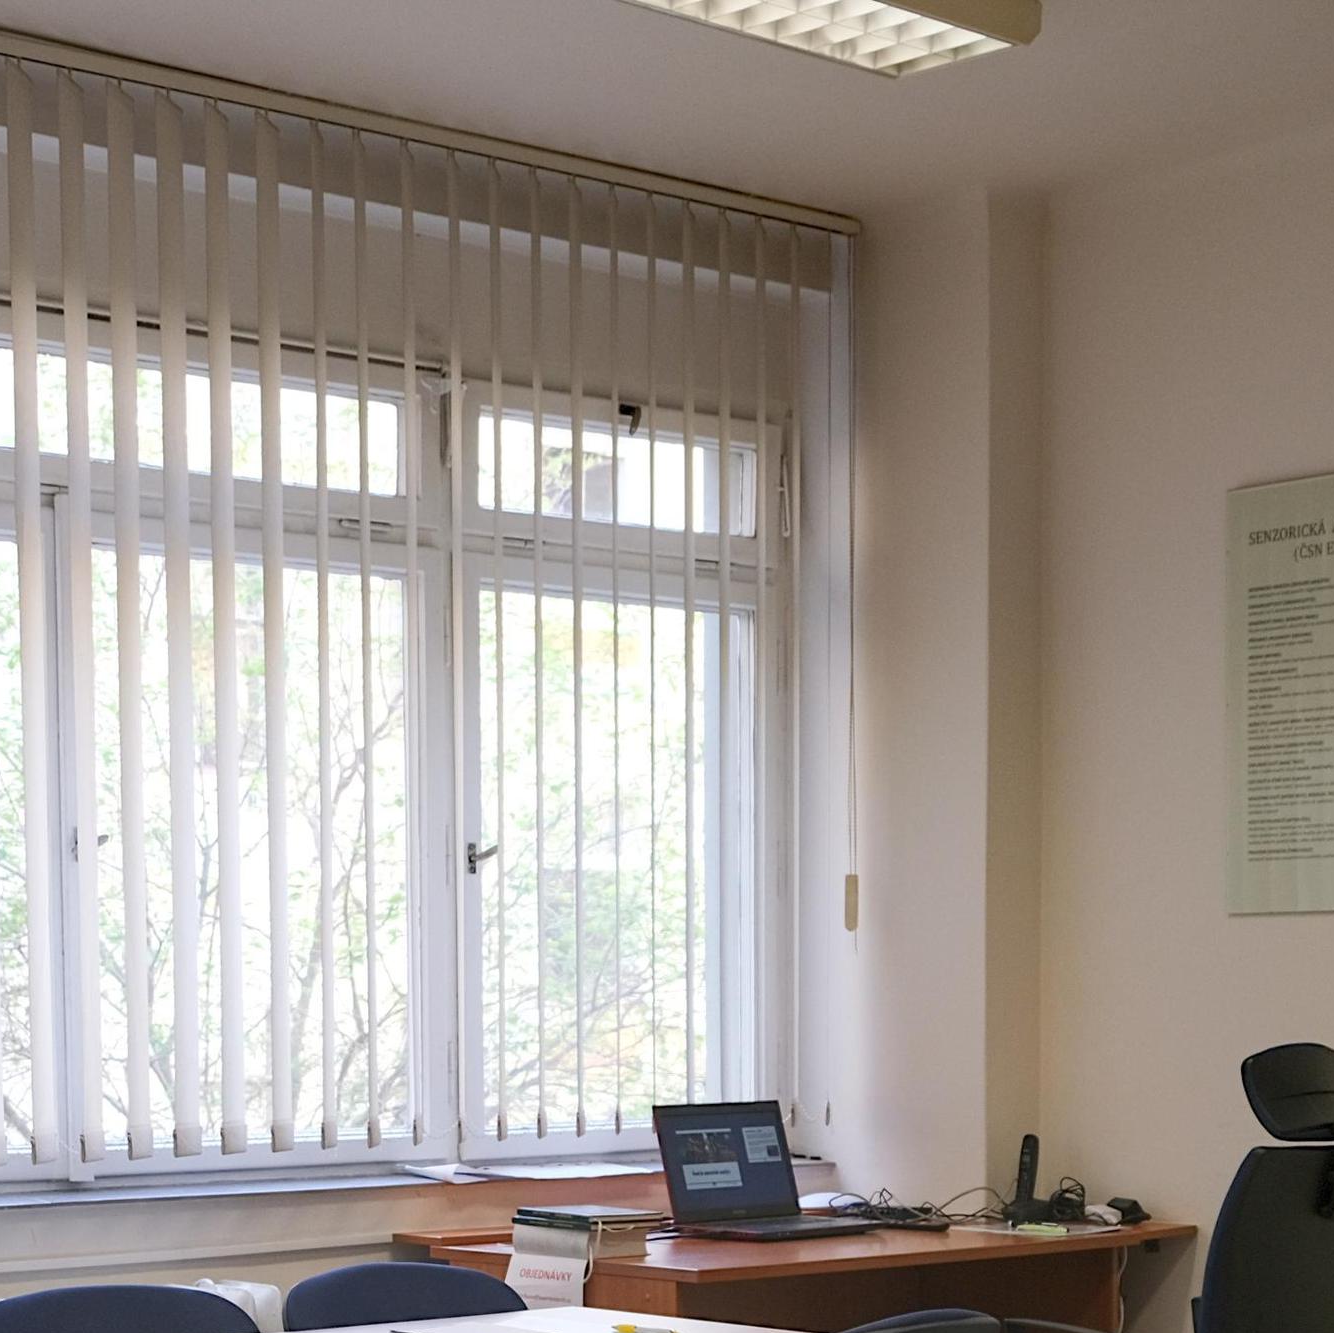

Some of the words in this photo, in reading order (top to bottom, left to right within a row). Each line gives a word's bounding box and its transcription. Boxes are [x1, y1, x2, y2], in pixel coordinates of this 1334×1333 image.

[1248, 518, 1326, 546] SENZORICKÁ
[1294, 541, 1323, 563] (ČSN
[519, 1267, 572, 1281] OBJEDNÁVKY
